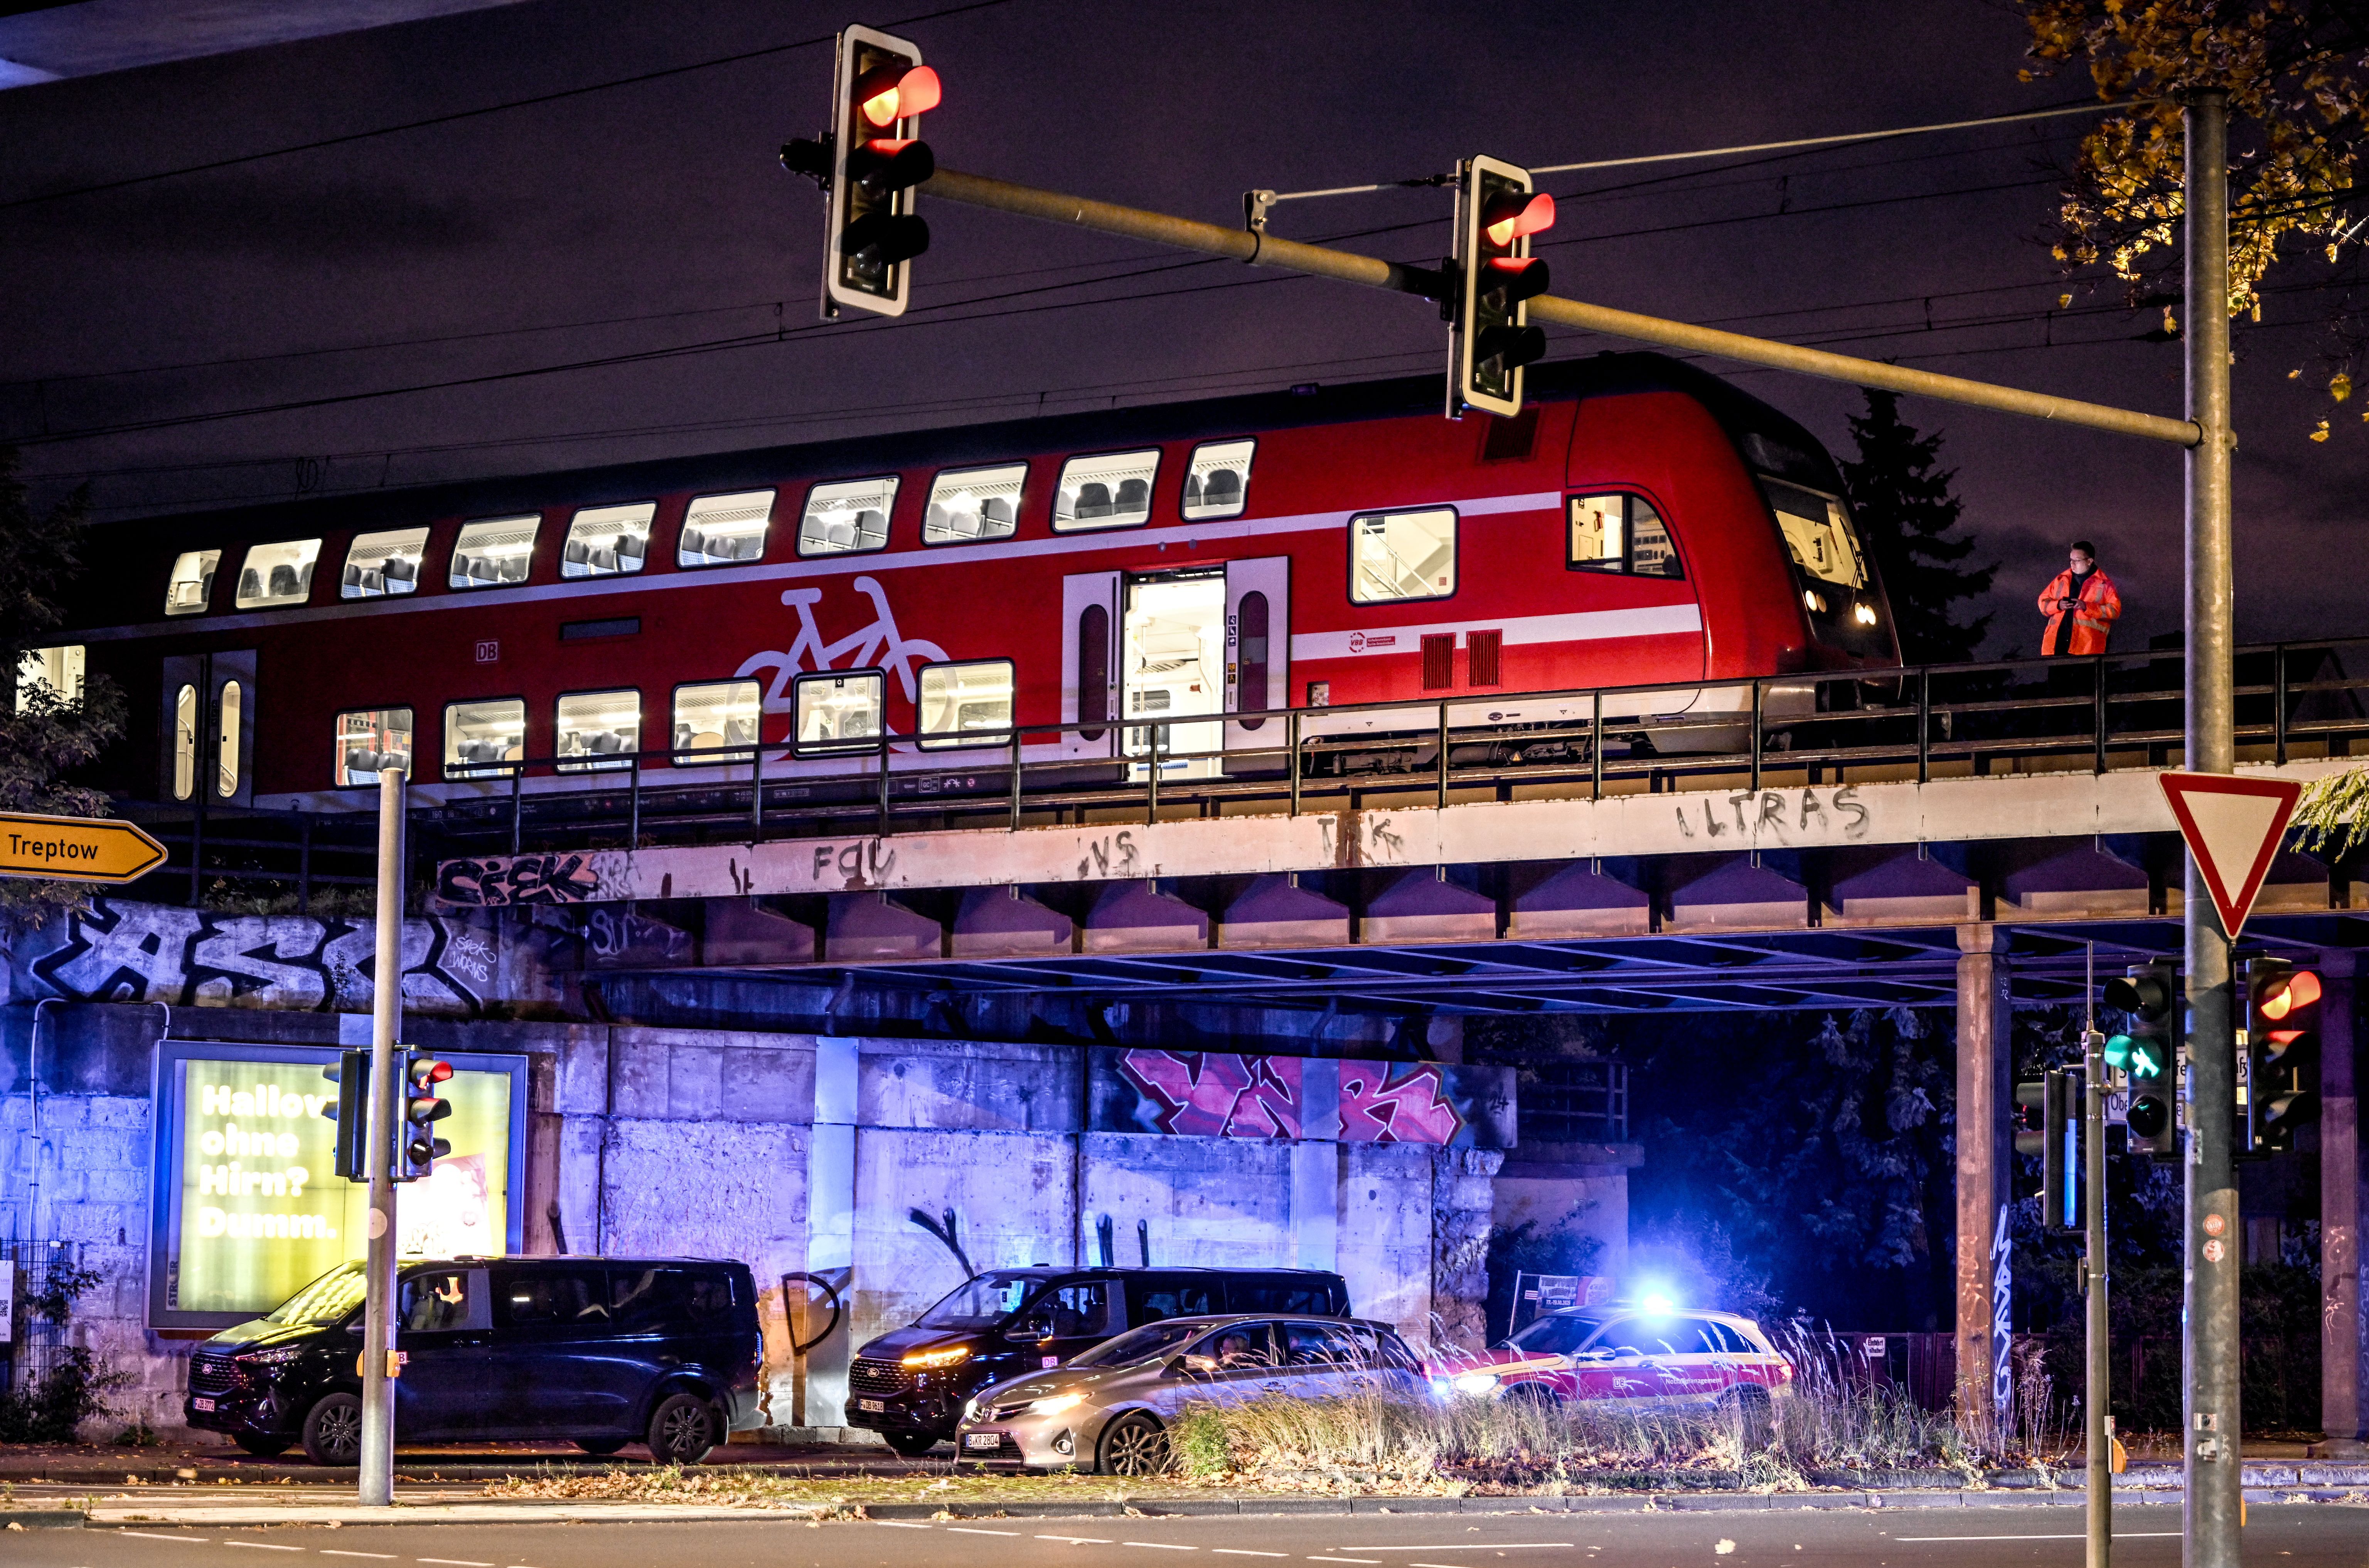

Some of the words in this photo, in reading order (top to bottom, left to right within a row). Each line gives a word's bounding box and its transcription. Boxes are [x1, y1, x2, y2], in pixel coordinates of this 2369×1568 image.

[477, 643, 497, 660] DB
[8, 834, 98, 862] Treptow
[201, 1083, 404, 1119] Hallow
[199, 1122, 300, 1157] ohne
[198, 1160, 310, 1198] Hirn?
[197, 1206, 337, 1239] Dumm.
[1045, 1358, 1055, 1366] DB
[199, 1400, 204, 1409] DB
[204, 1400, 214, 1410] 3772
[866, 1401, 871, 1409] DB
[872, 1402, 883, 1411] 9618
[969, 1435, 972, 1445] B
[975, 1435, 982, 1445] KR
[983, 1435, 998, 1445] 2804
